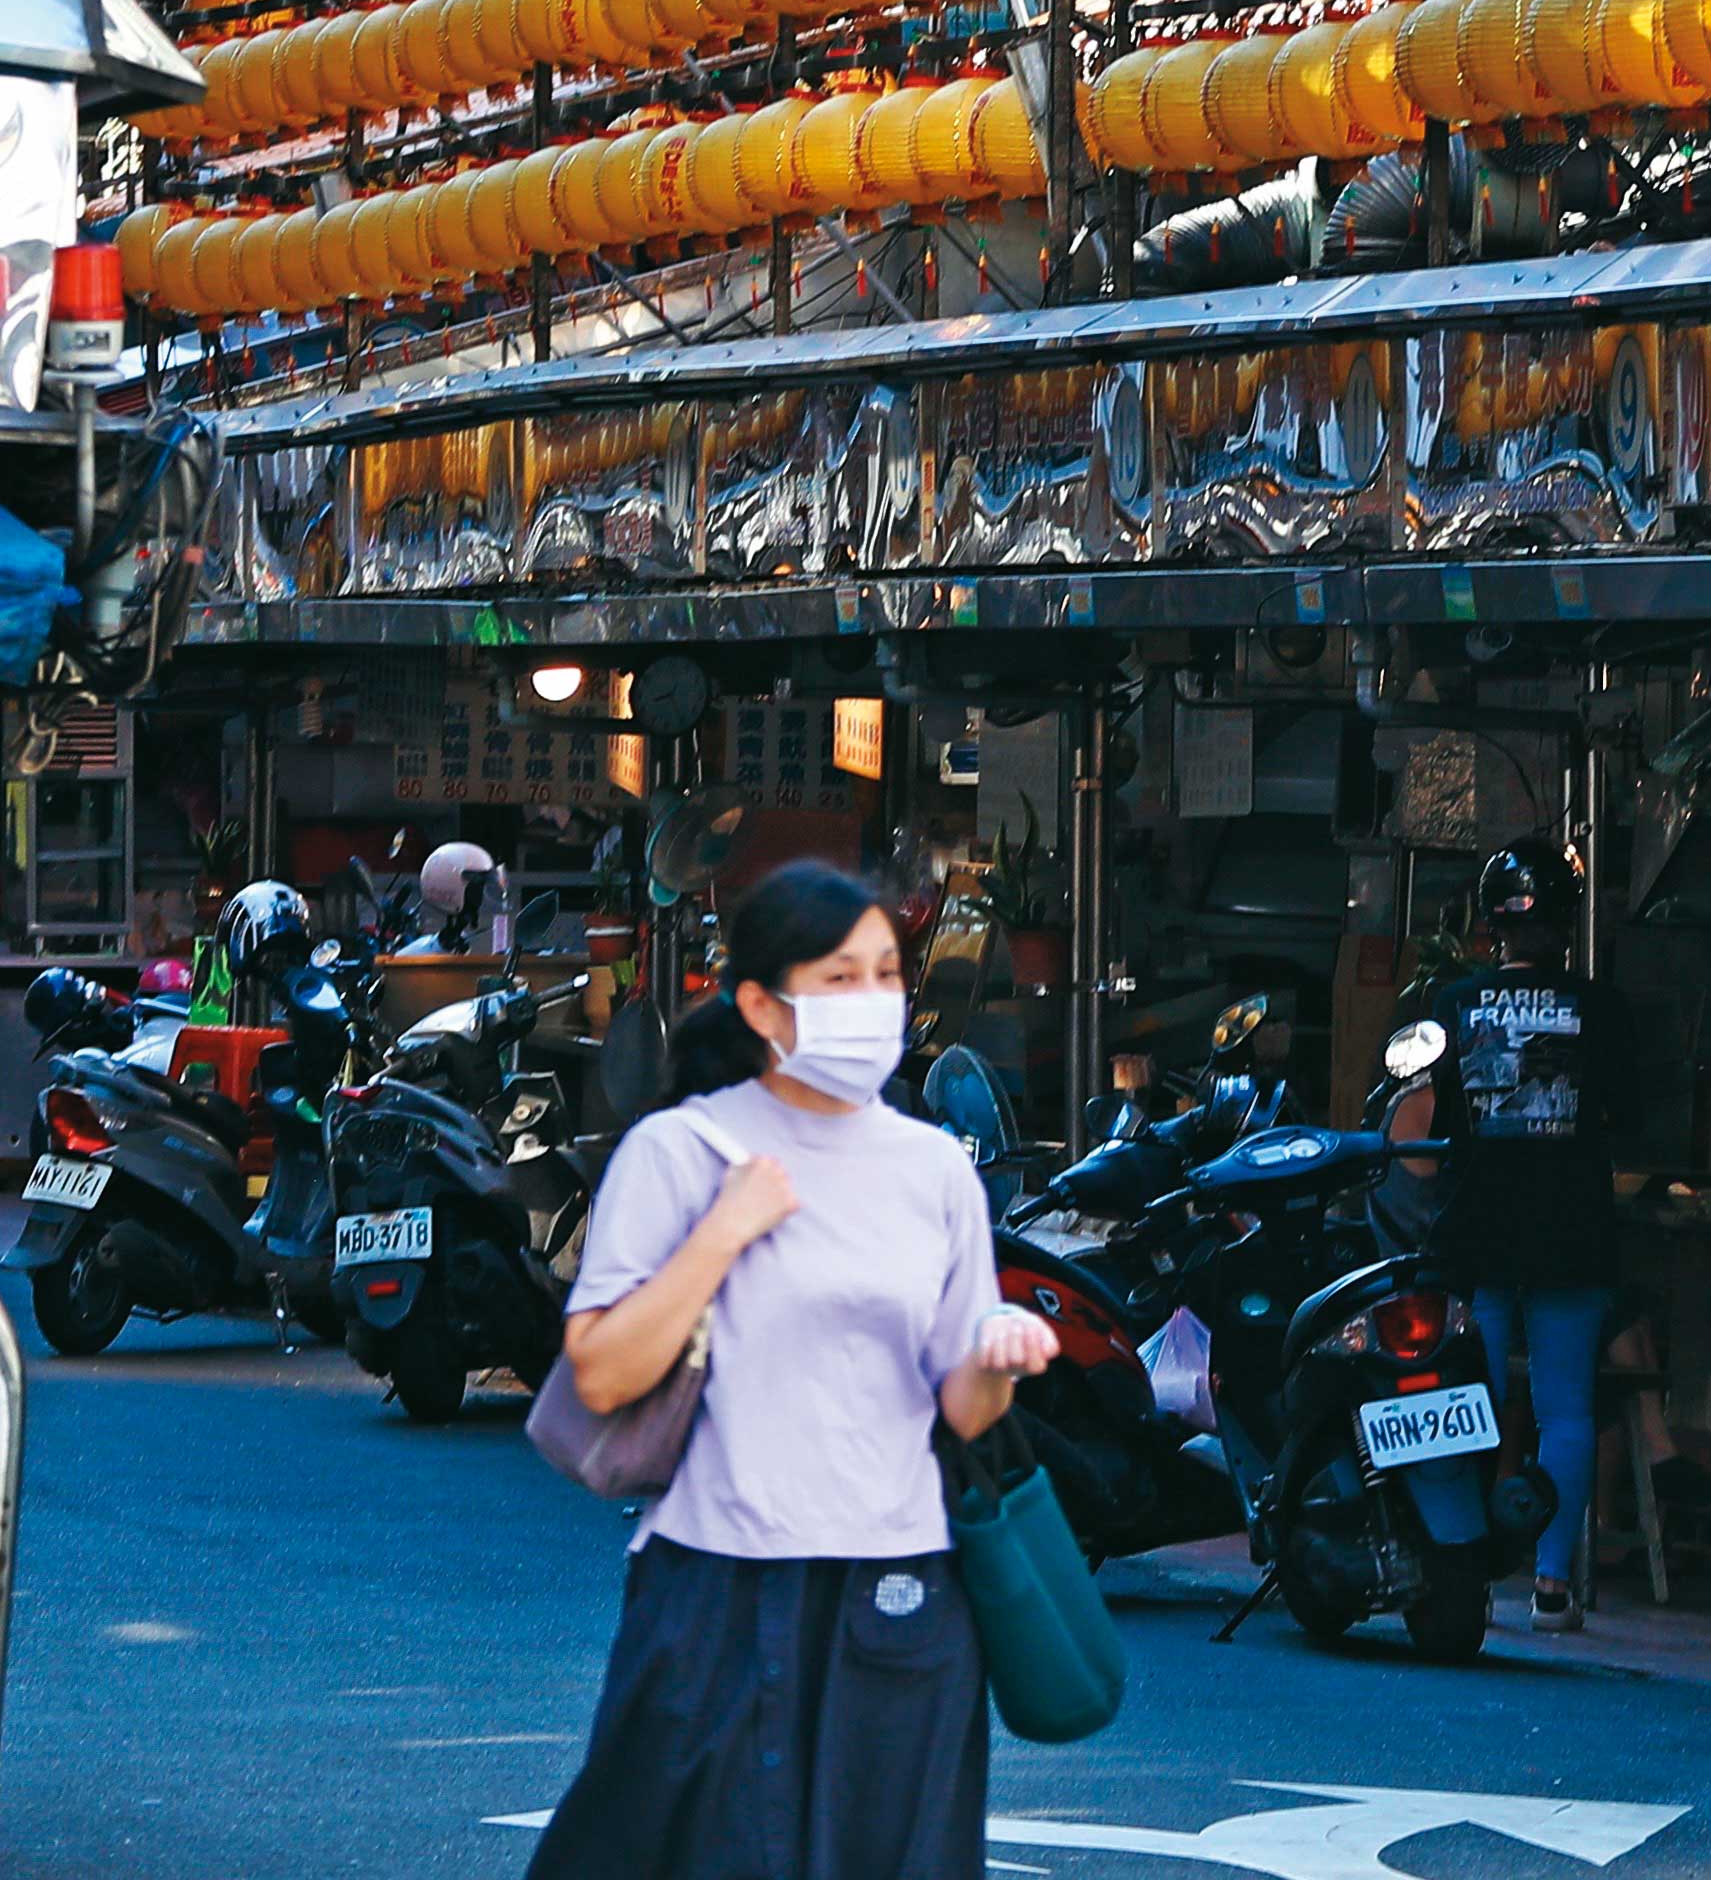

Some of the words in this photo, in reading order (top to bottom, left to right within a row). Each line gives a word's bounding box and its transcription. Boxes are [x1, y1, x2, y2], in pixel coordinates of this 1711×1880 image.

[1615, 356, 1639, 453] 9
[1479, 987, 1556, 1008] PARIS
[1469, 1006, 1574, 1030] FRANCE
[1368, 1400, 1489, 1453] NRN-9601
